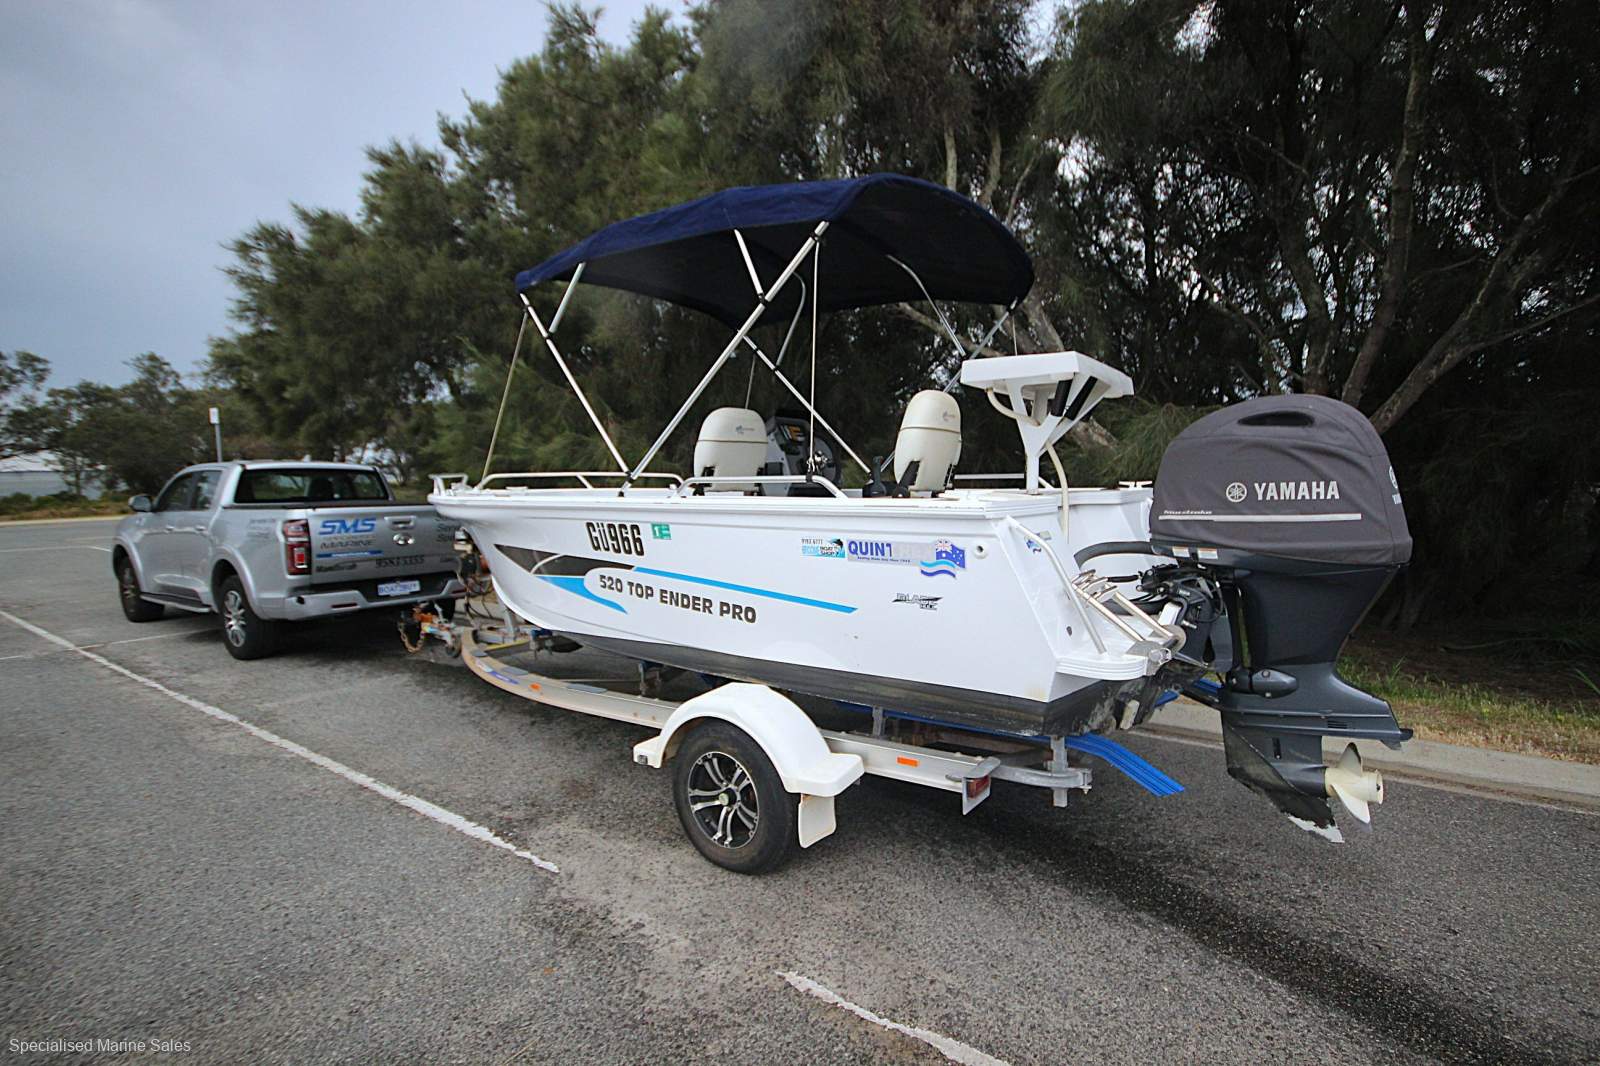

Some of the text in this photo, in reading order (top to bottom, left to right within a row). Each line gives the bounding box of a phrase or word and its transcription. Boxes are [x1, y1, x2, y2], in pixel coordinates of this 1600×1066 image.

[1254, 480, 1340, 501] YAMAHA
[319, 517, 377, 535] SMS
[599, 574, 757, 624] 520 TOP ENDER PRO
